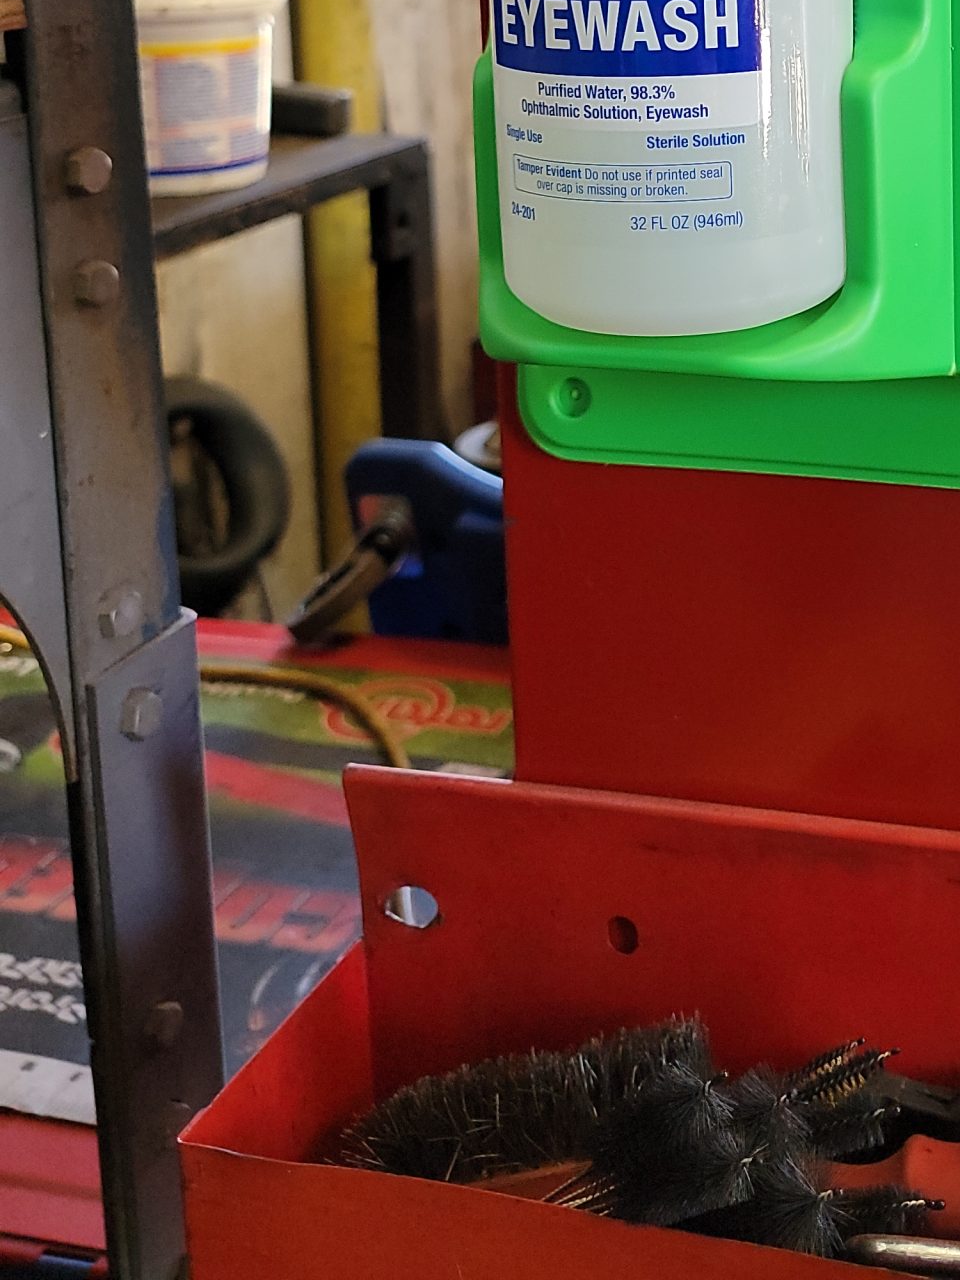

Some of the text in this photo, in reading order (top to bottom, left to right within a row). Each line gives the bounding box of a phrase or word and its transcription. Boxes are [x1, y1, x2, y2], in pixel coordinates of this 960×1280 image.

[537, 81, 675, 102] Purified Water, 98.3%
[521, 98, 709, 122] Ophthalmic Solution, Eyewash
[526, 129, 543, 144] Use
[646, 132, 745, 149] Sterile Solution
[516, 158, 723, 183] Tamper Evident Do not use if printed seal
[536, 179, 688, 199] over cap is missing or broken.
[630, 211, 743, 232] 32 FL OZ (946ml)
